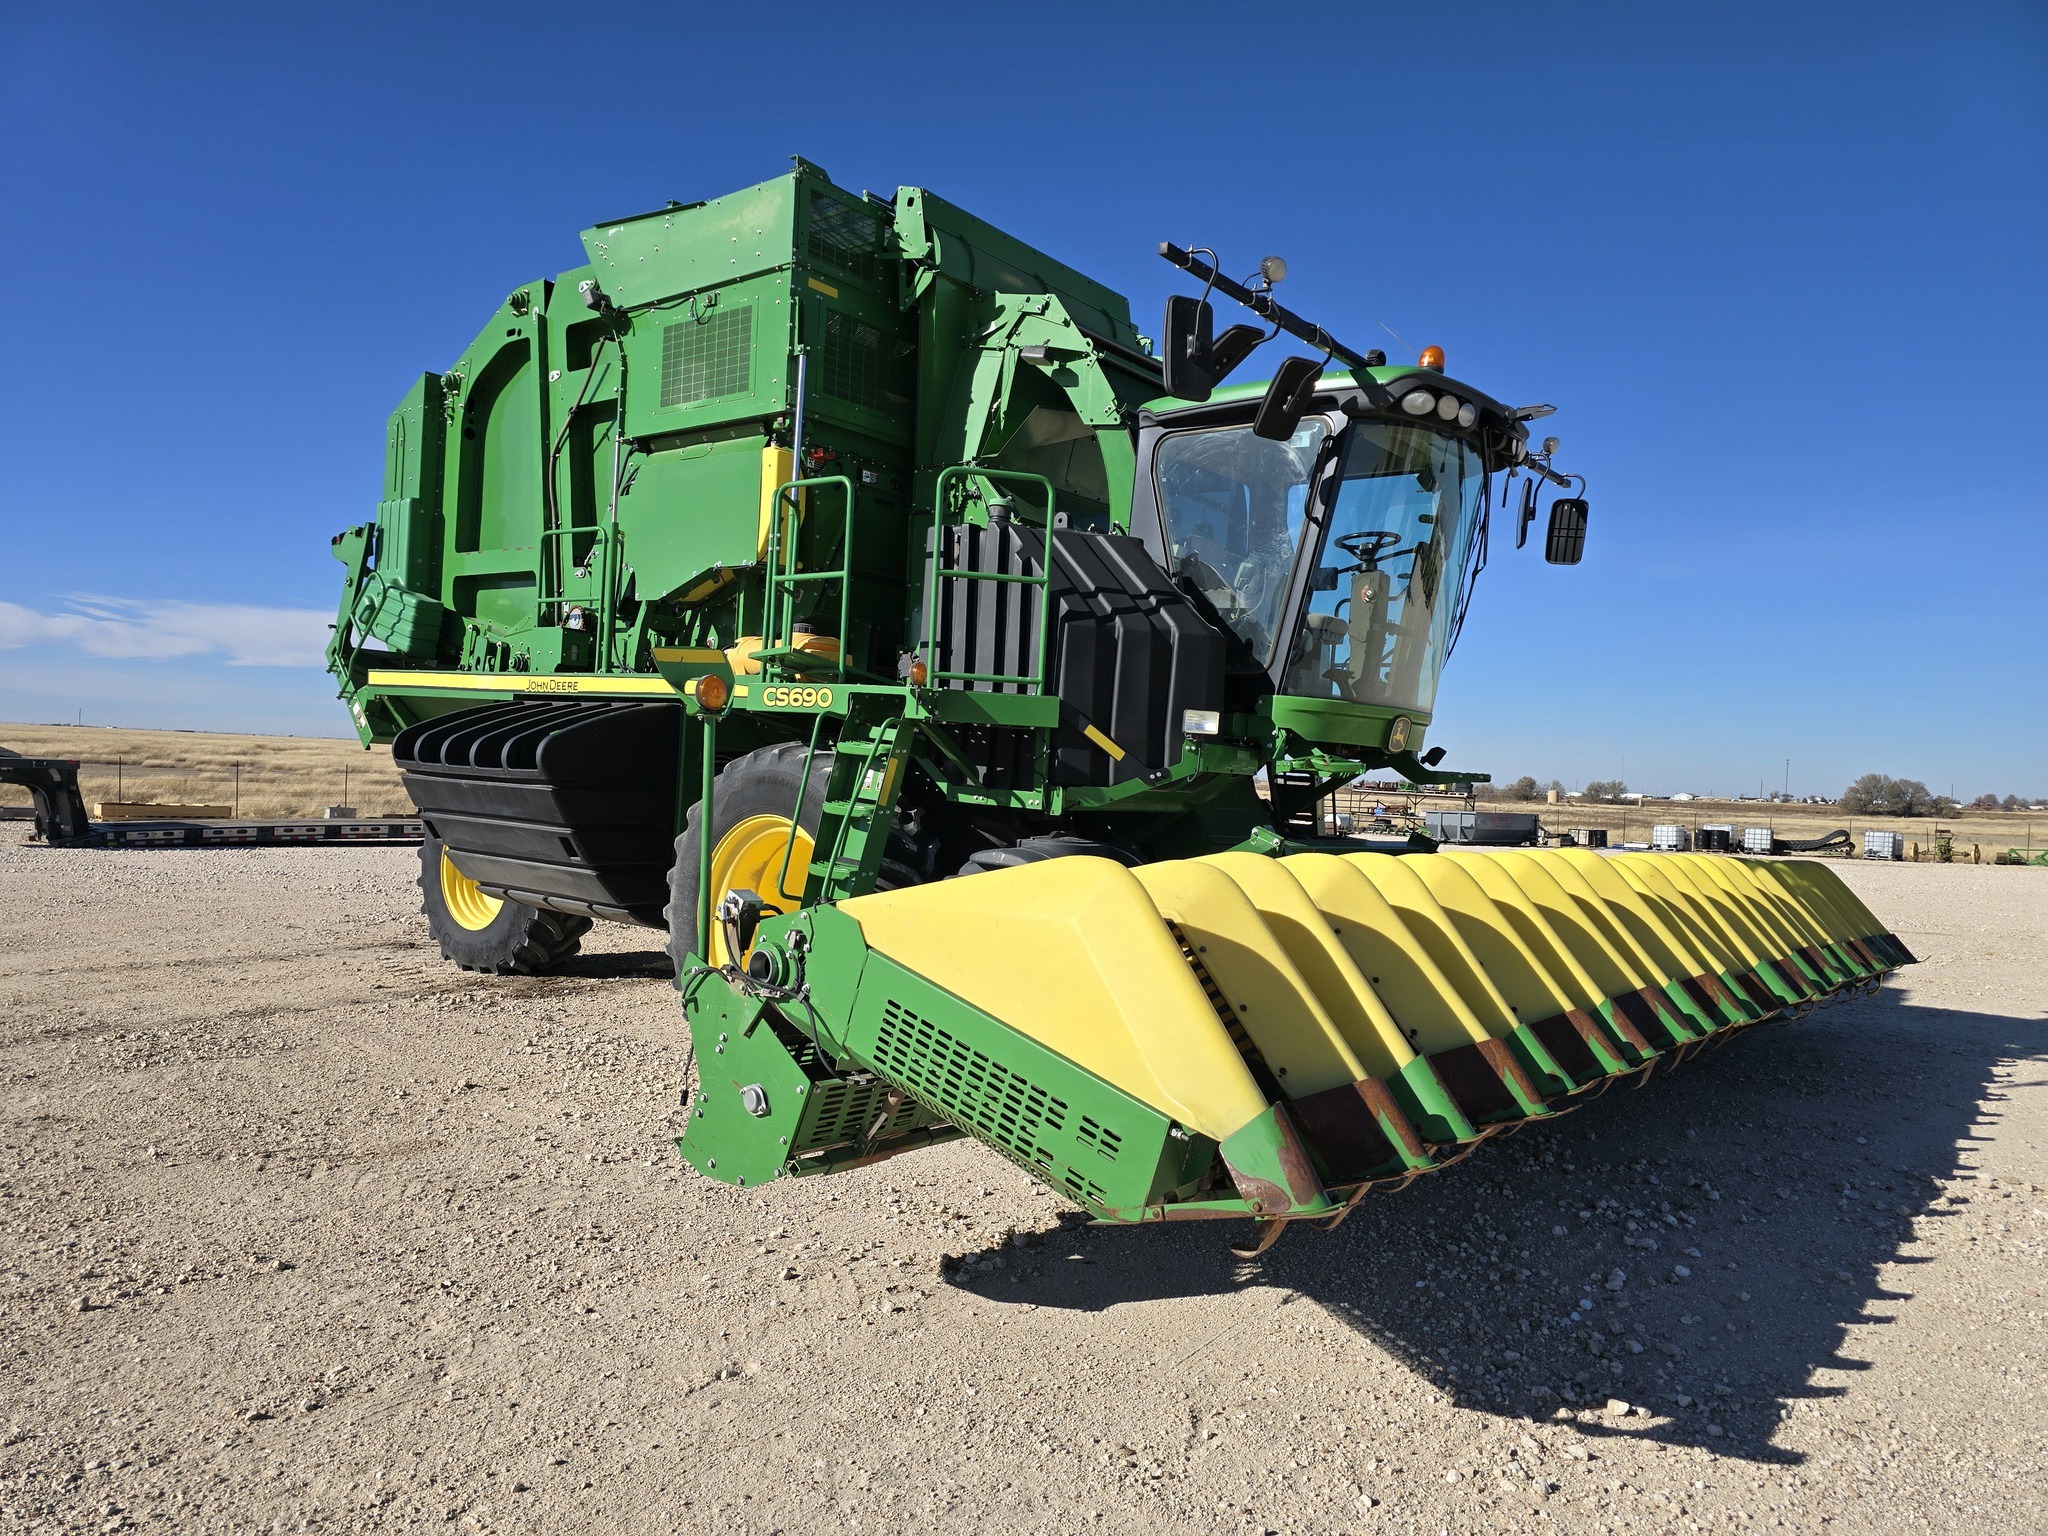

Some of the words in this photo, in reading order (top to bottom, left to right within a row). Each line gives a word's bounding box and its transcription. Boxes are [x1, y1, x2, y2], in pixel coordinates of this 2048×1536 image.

[526, 679, 548, 690] JOHN
[550, 679, 579, 691] DEERE
[763, 686, 833, 708] CS690
